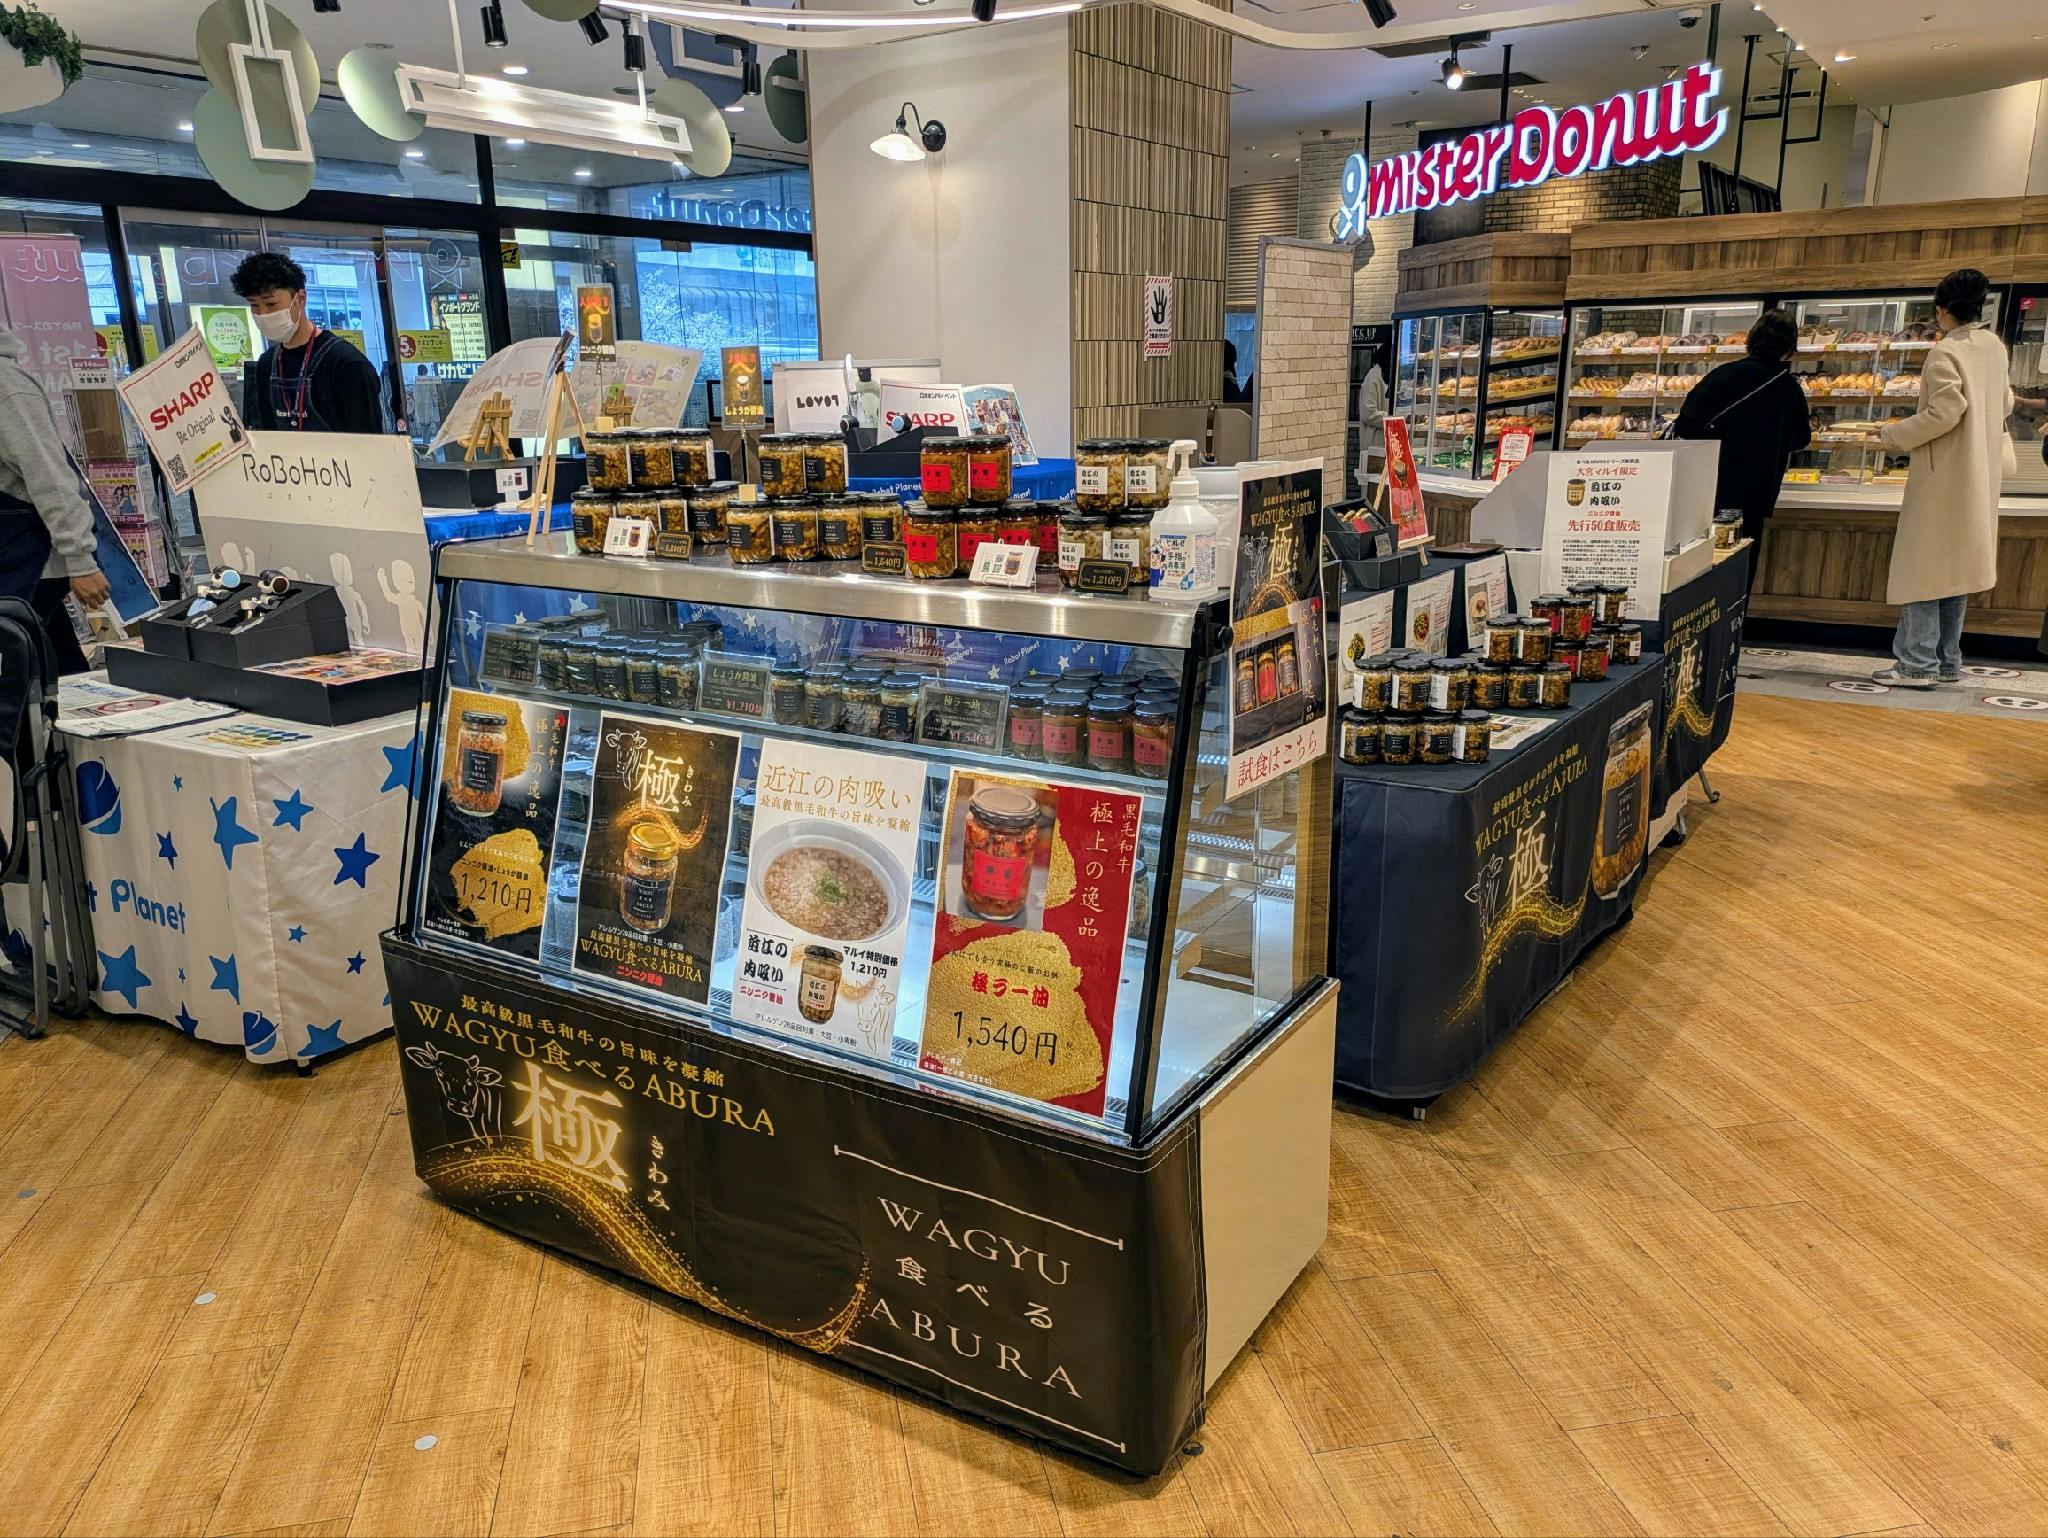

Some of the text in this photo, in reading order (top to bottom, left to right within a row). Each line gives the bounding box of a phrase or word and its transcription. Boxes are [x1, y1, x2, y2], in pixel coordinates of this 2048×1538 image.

[1509, 62, 1729, 186] Donut
[1352, 327, 1376, 338] ICK UP
[150, 371, 214, 431] SHARP
[176, 408, 216, 445] Be Original
[886, 411, 955, 428] SARP
[242, 453, 352, 488] RoBoHoN
[1576, 466, 1639, 476] 大宮マルイ限定
[1591, 481, 1622, 492] 近江の
[1567, 519, 1641, 532] 先行50食販売
[1268, 523, 1294, 581] 極
[1092, 575, 1122, 586] 1,210円
[525, 718, 548, 818] 極上の逸品
[633, 749, 684, 814] 極
[1238, 729, 1318, 790] 試食はこちら
[682, 765, 695, 807] きわみ
[763, 763, 912, 811] 近江の肉吸い
[760, 794, 912, 833] 最高級黒毛和牛の旨味を凝縮
[1116, 802, 1137, 874] 黒毛和牛
[1077, 799, 1114, 938] 極上の逸品
[1504, 810, 1549, 911] 極
[110, 879, 186, 934] Planet
[461, 872, 532, 915] 1,210円
[580, 938, 703, 983] WAGYU食べるABURA
[743, 958, 784, 983] 肉吸い
[748, 934, 788, 959] 近江の
[842, 945, 899, 968] マルイ特別価格
[850, 961, 888, 979] 1,210円
[971, 971, 1050, 1009] 極ラー油
[460, 993, 726, 1088] 最高級黒毛和牛の旨味を凝縮
[953, 1010, 1059, 1067] 1,540円
[409, 999, 777, 1137] WAGYU食べるABURA
[511, 1060, 630, 1193] 極
[647, 1135, 671, 1212] きわみ
[876, 1195, 1071, 1286] WAGYU
[895, 1256, 1054, 1330] 食べる
[869, 1298, 1083, 1399] ABURA
